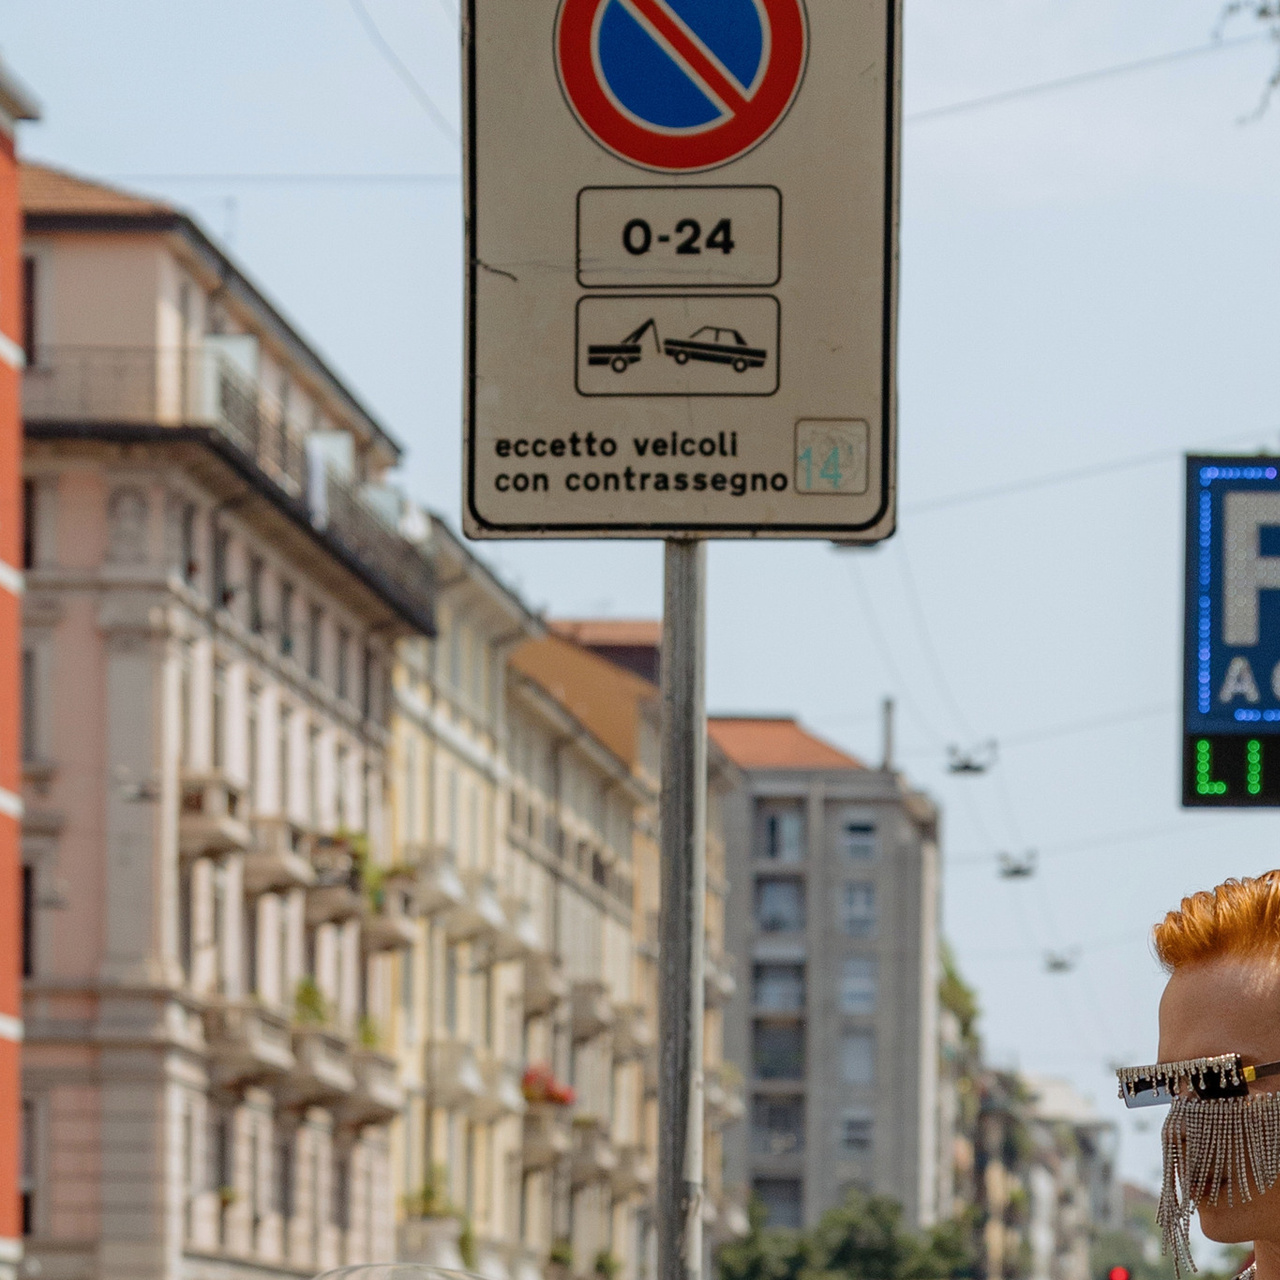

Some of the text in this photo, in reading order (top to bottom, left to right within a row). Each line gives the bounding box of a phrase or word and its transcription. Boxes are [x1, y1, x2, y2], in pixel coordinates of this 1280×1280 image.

[622, 218, 735, 255] 0-24
[494, 431, 739, 457] eccetto veicoli
[494, 467, 789, 496] con contrassegno
[797, 446, 843, 489] 14
[1219, 656, 1260, 703] A
